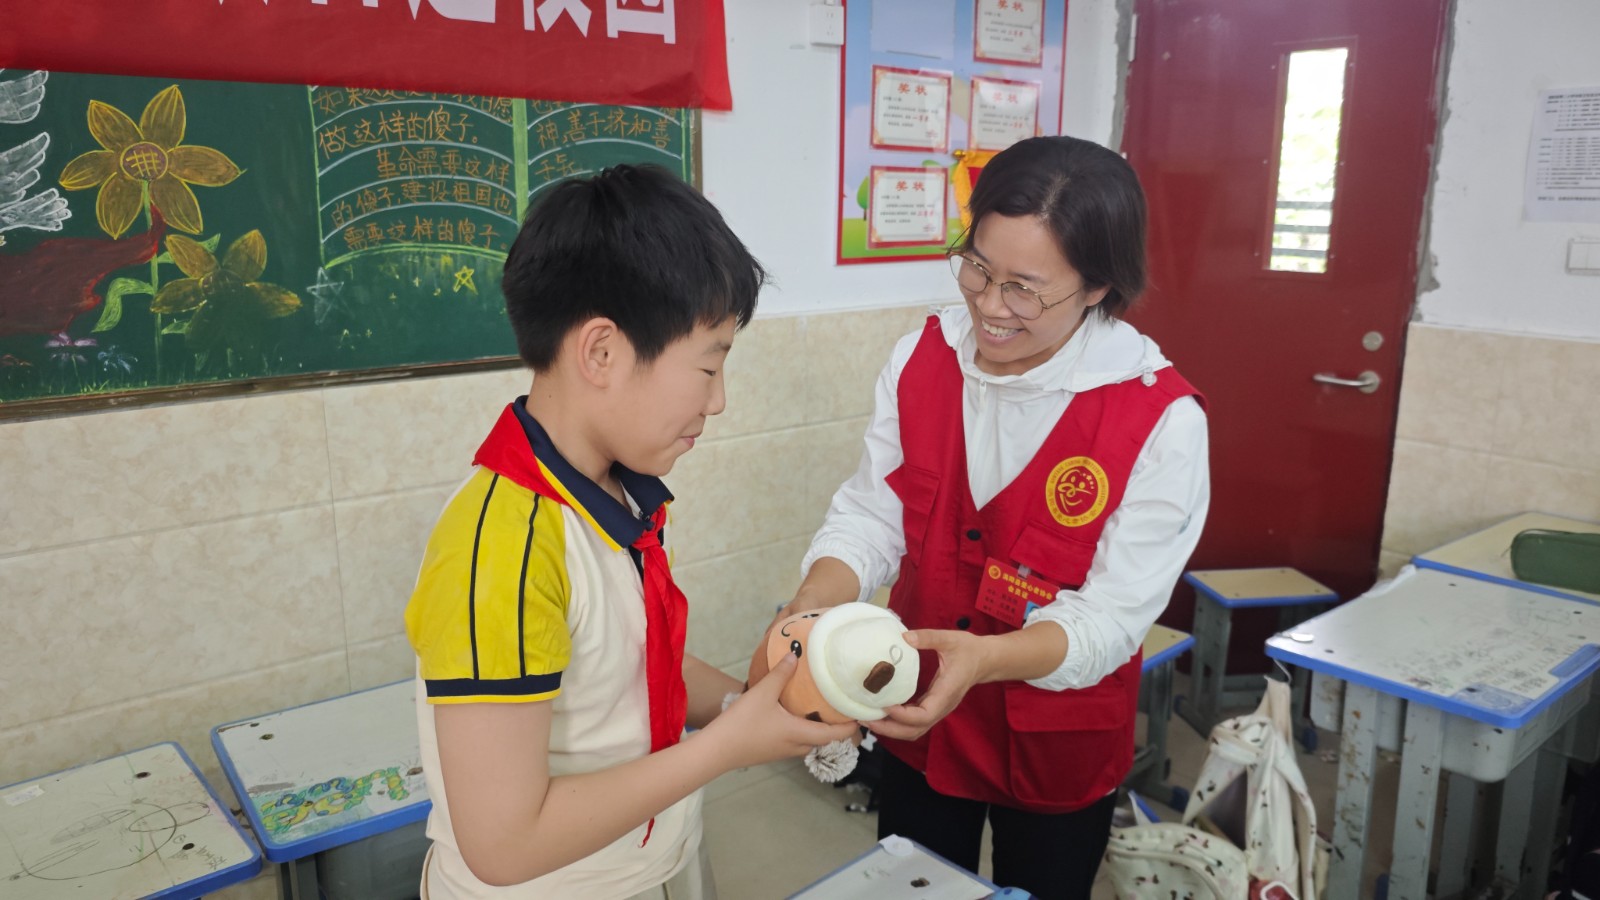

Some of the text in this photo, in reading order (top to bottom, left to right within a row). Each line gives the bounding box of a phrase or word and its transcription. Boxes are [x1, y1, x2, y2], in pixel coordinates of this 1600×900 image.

[897, 82, 928, 96] 奖状
[376, 146, 510, 188] 革命需要这样
[896, 180, 926, 192] 奖状
